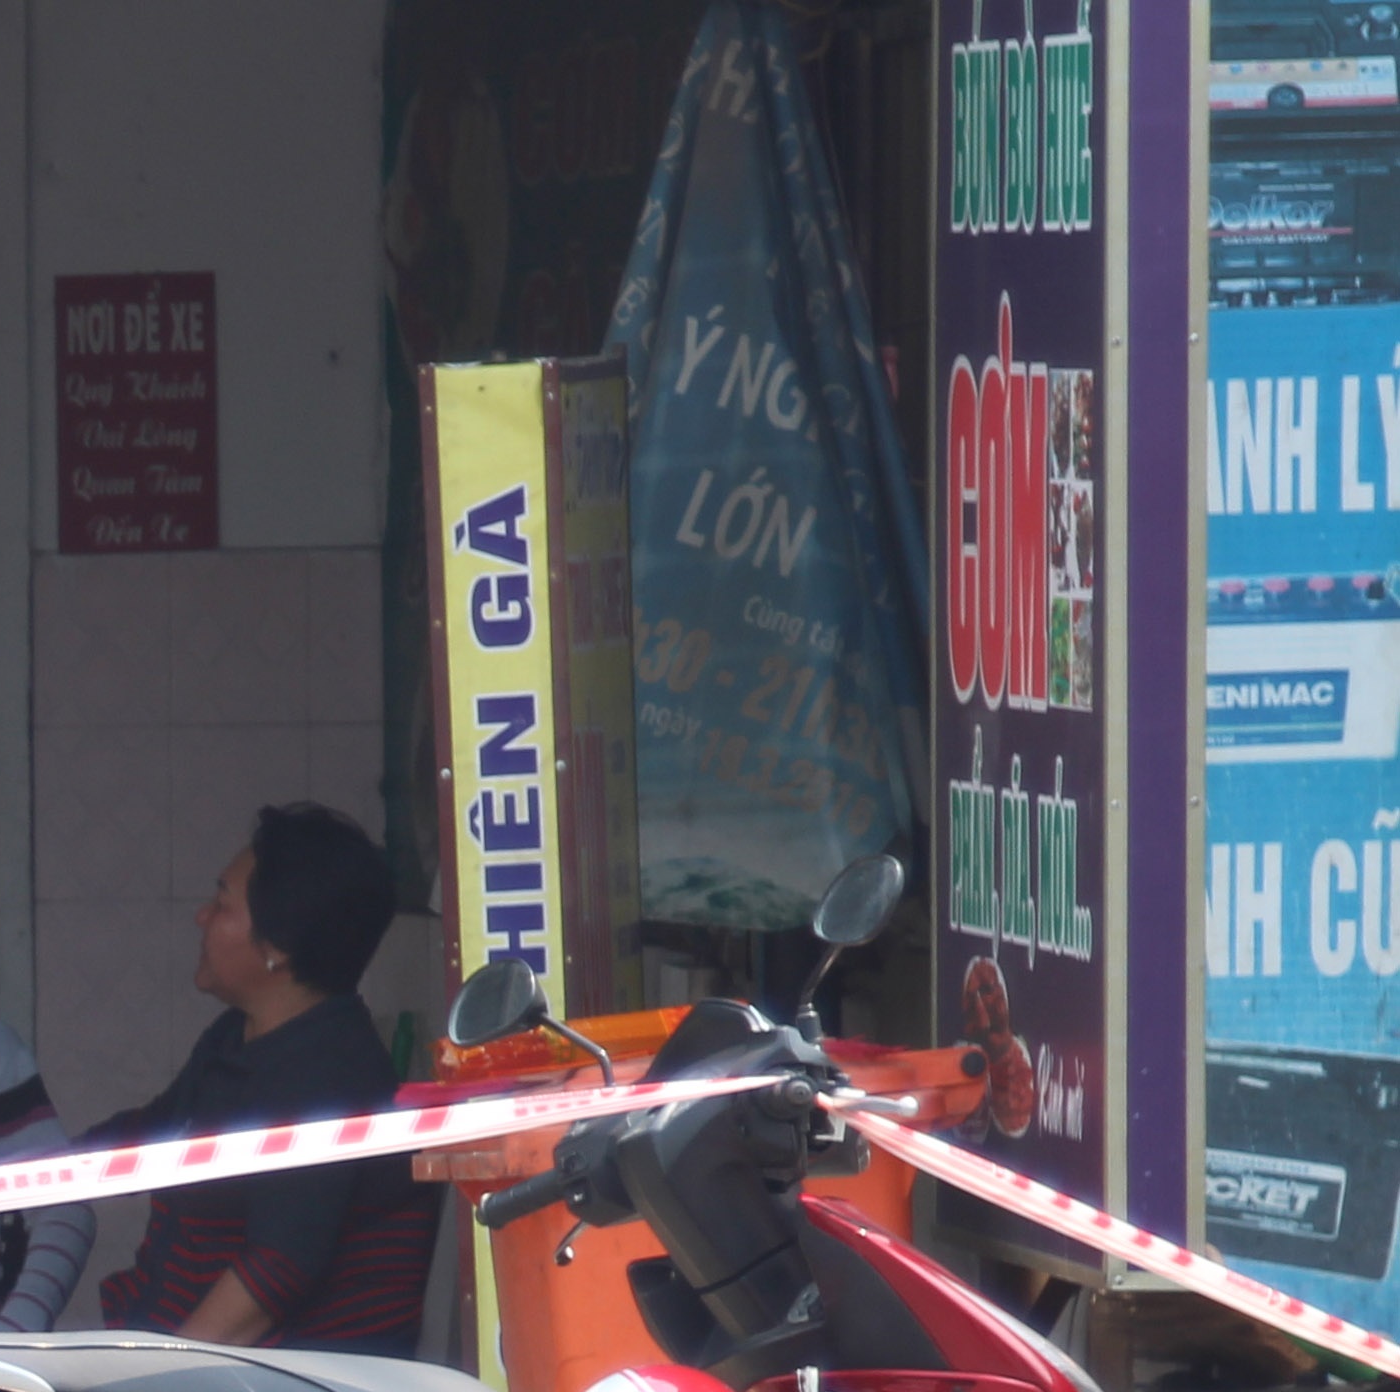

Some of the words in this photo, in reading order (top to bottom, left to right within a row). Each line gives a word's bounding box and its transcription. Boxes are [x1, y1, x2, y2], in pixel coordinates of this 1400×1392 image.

[168, 300, 205, 352] XE
[452, 482, 535, 652] GÀ
[674, 466, 817, 579] LỚN
[946, 289, 1049, 713] CƠM
[1205, 679, 1336, 710] ENIMAC
[466, 691, 548, 977] HIÊN
[1309, 806, 1400, 978] CŨ
